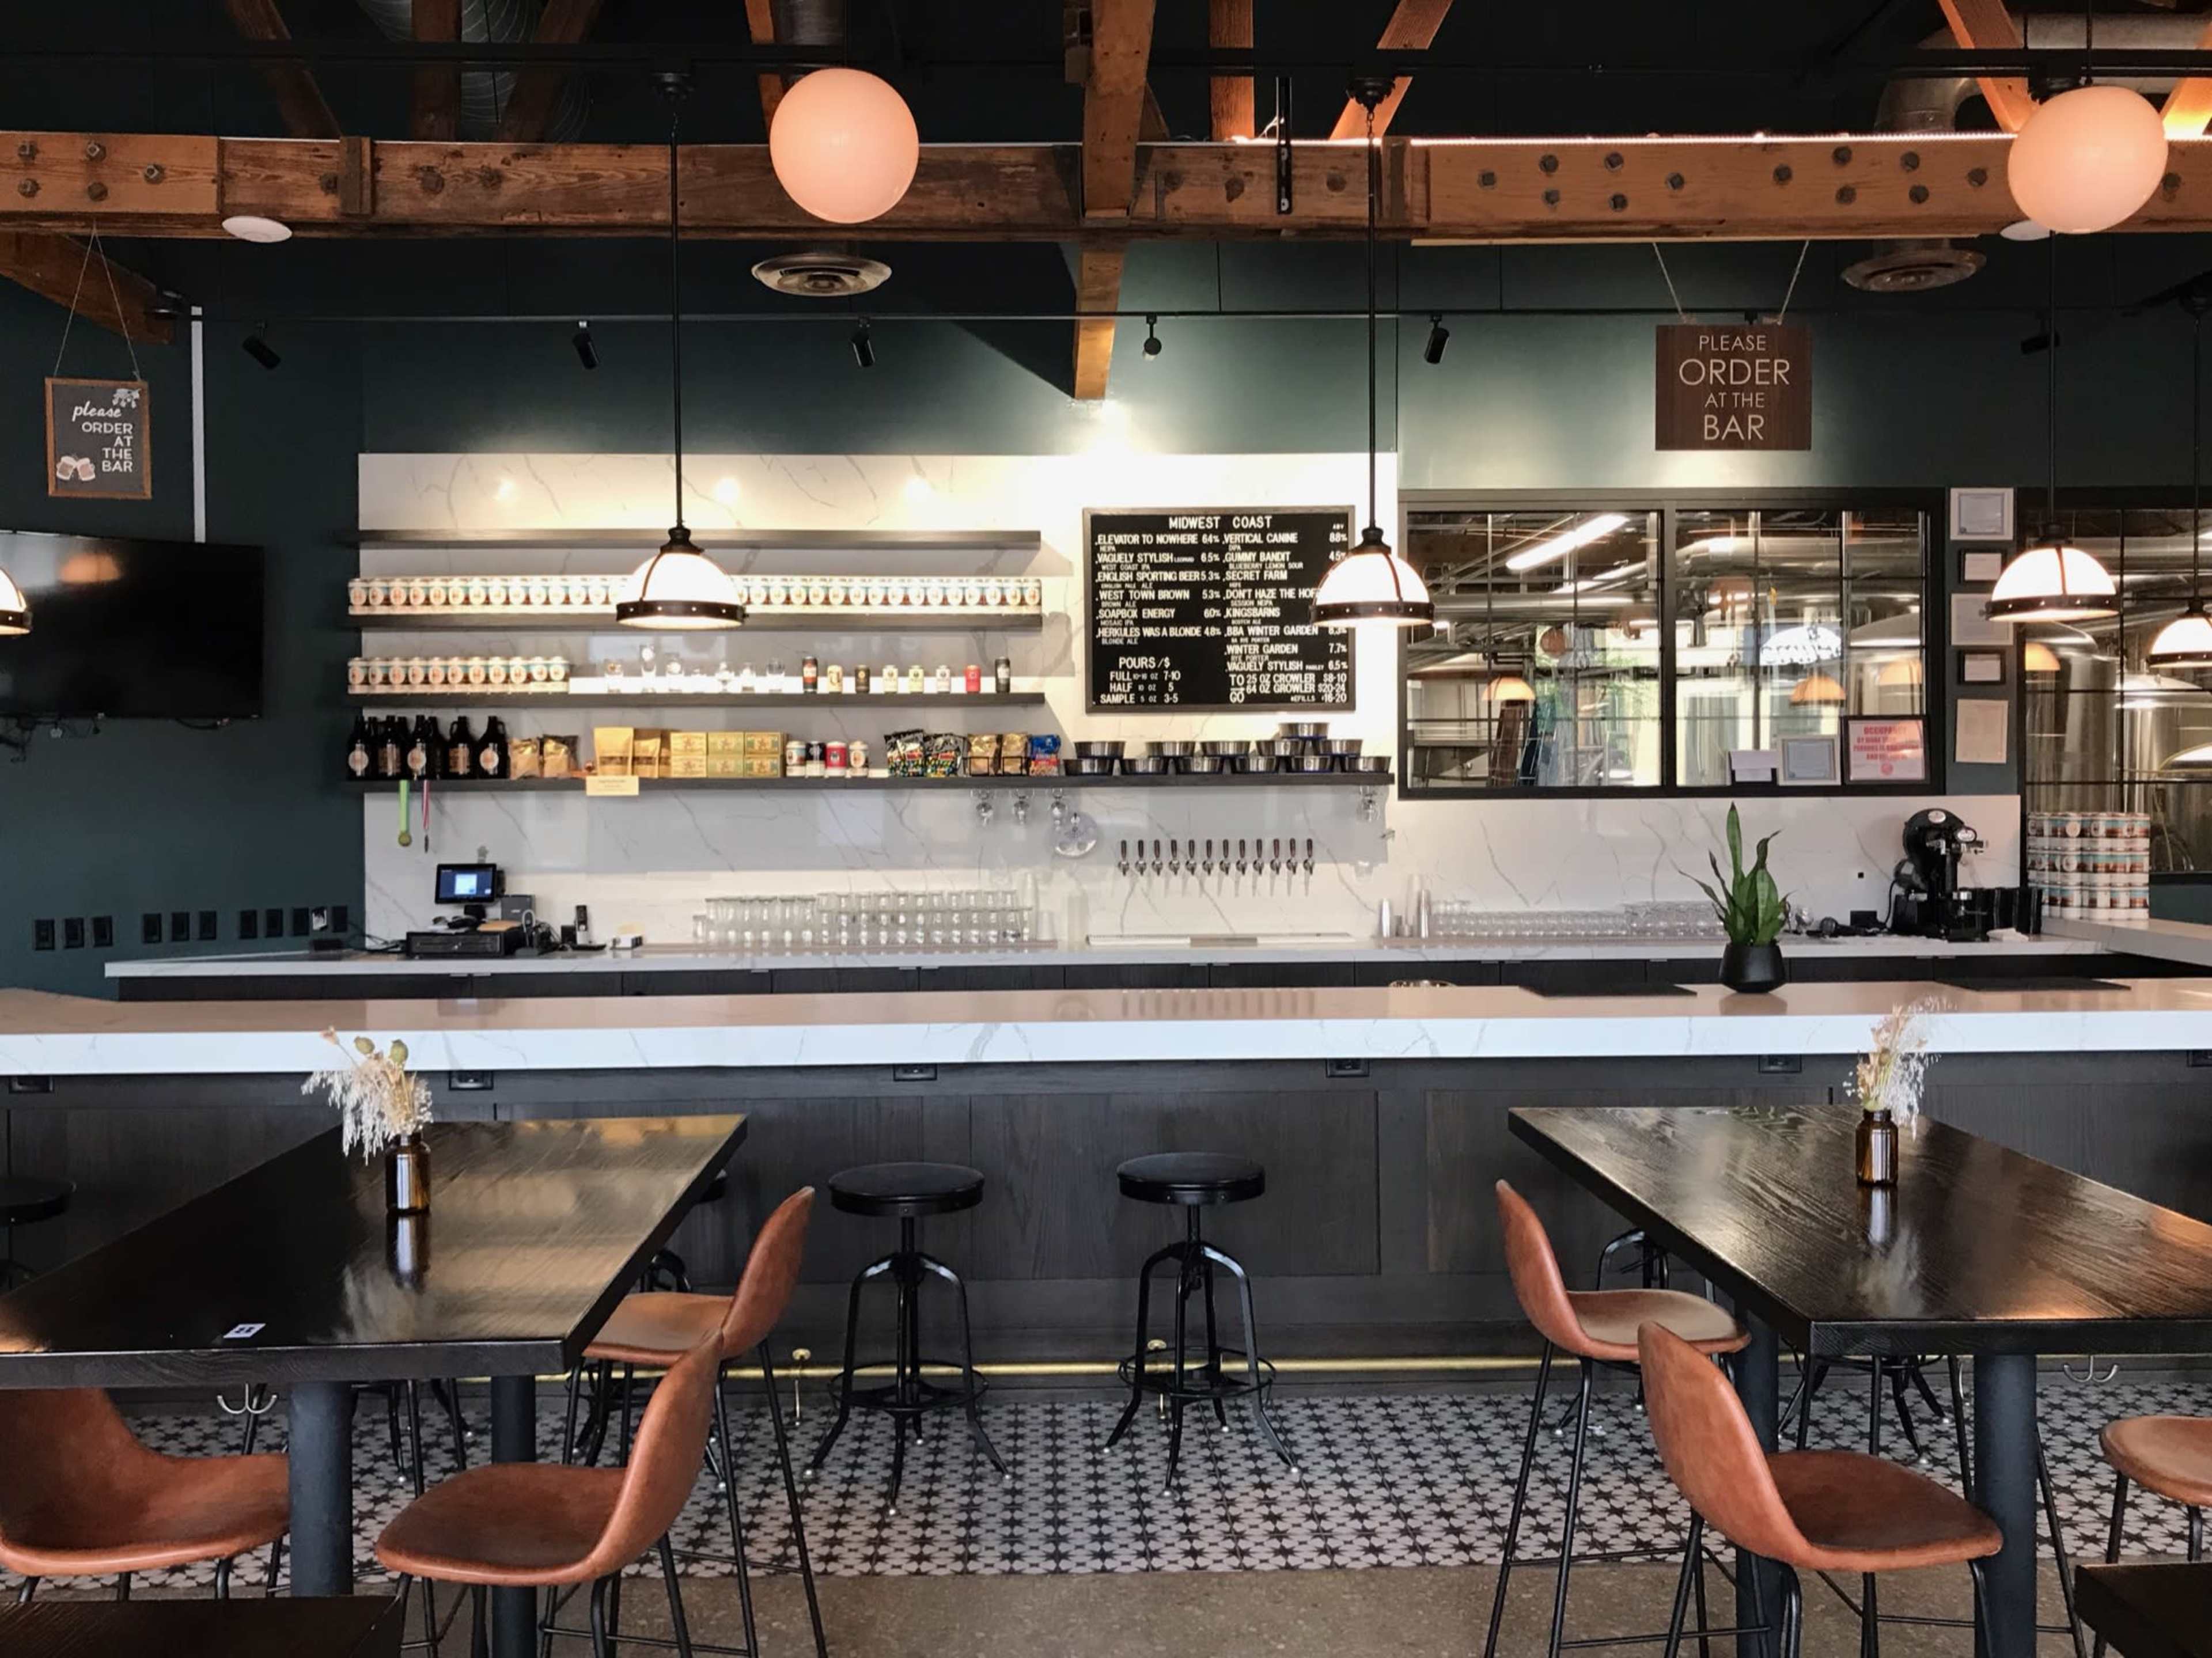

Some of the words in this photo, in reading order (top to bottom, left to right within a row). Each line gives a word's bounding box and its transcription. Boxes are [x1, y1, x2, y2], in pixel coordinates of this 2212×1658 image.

[1699, 335, 1766, 351] PLEASE
[1679, 358, 1790, 386] ORDER
[1705, 392, 1727, 408] AT
[1732, 392, 1765, 408] THE
[71, 400, 122, 422] please
[82, 421, 133, 435] ORDER
[1704, 414, 1764, 441] BAR
[114, 436, 133, 447] AT
[102, 447, 132, 460] THE
[101, 460, 133, 473] BAR
[1169, 517, 1221, 529] MIDWEST
[1232, 516, 1272, 529] COAST
[1097, 534, 1139, 545] ELEVATOR
[1142, 533, 1153, 545] TO
[1156, 533, 1198, 544] NOWHERE
[1224, 533, 1263, 544] VERTICAL
[1266, 532, 1298, 544] CANINE
[1097, 552, 1134, 563] VAGUELY
[1137, 552, 1173, 563] STYLISH
[1225, 551, 1256, 563] GUMMY
[1260, 551, 1291, 562] BANDIT
[1097, 571, 1133, 582] ENGLISH
[1136, 571, 1177, 582] SPORTING
[1179, 571, 1200, 582] BEER
[1225, 570, 1260, 581] SECRET
[1263, 570, 1287, 581] FARM
[1099, 589, 1124, 600] WEST
[1128, 589, 1155, 600] TOWN
[1158, 589, 1190, 600] BROWN
[1255, 588, 1277, 600] HAZE
[1279, 588, 1296, 600] THE
[1099, 608, 1138, 619] SOAPBOX
[1142, 608, 1176, 619] ENERGY
[1225, 606, 1281, 618] KINGSBARNS
[1098, 627, 1140, 638] HERKULES
[1142, 627, 1160, 638] WAS
[1161, 627, 1168, 638] A
[1169, 626, 1202, 637] BLONDE
[1226, 625, 1244, 636] BBA
[1248, 625, 1280, 636] WINTER
[1283, 625, 1319, 636] GARDEN
[1226, 644, 1260, 655] WINTER
[1263, 643, 1298, 654] GARDEN
[1328, 643, 1347, 654] 7.7%
[1119, 657, 1156, 669] POURS
[1226, 661, 1264, 671] VAGUELY
[1267, 661, 1303, 671] STYLISH
[1109, 670, 1132, 681] FULL
[1164, 670, 1181, 681] 7-10
[1229, 674, 1245, 686] TO
[1246, 674, 1257, 684] 25
[1259, 674, 1271, 684] OZ
[1273, 673, 1316, 684] CROWLER
[1109, 682, 1133, 693] HALF
[1168, 682, 1174, 692] 5
[1246, 684, 1257, 694] 64
[1259, 683, 1271, 693] OZ
[1273, 682, 1316, 693] GROWLER
[1100, 693, 1135, 704] SAMPLE
[1164, 693, 1179, 703] 3-5
[1229, 691, 1245, 703] GO
